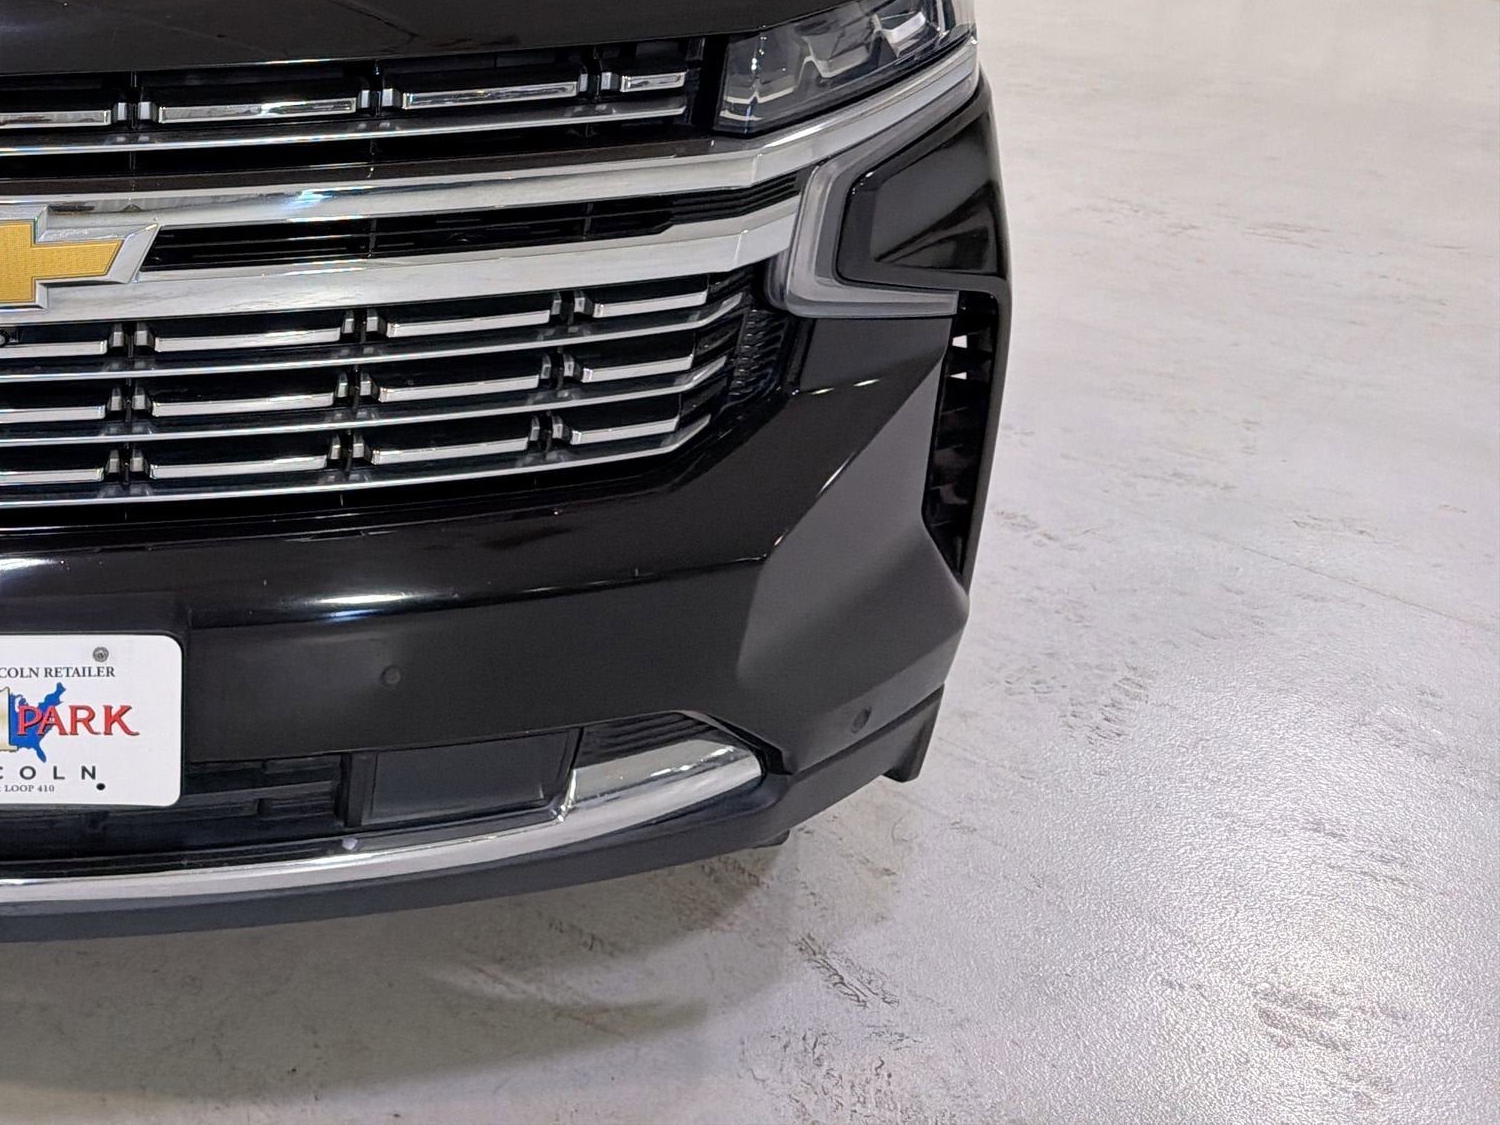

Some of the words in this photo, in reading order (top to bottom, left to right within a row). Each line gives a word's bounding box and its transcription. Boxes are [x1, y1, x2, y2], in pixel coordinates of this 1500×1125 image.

[44, 666, 116, 678] RETAILER
[17, 705, 140, 736] PARK
[5, 784, 34, 793] LOOP
[37, 784, 55, 793] 410
